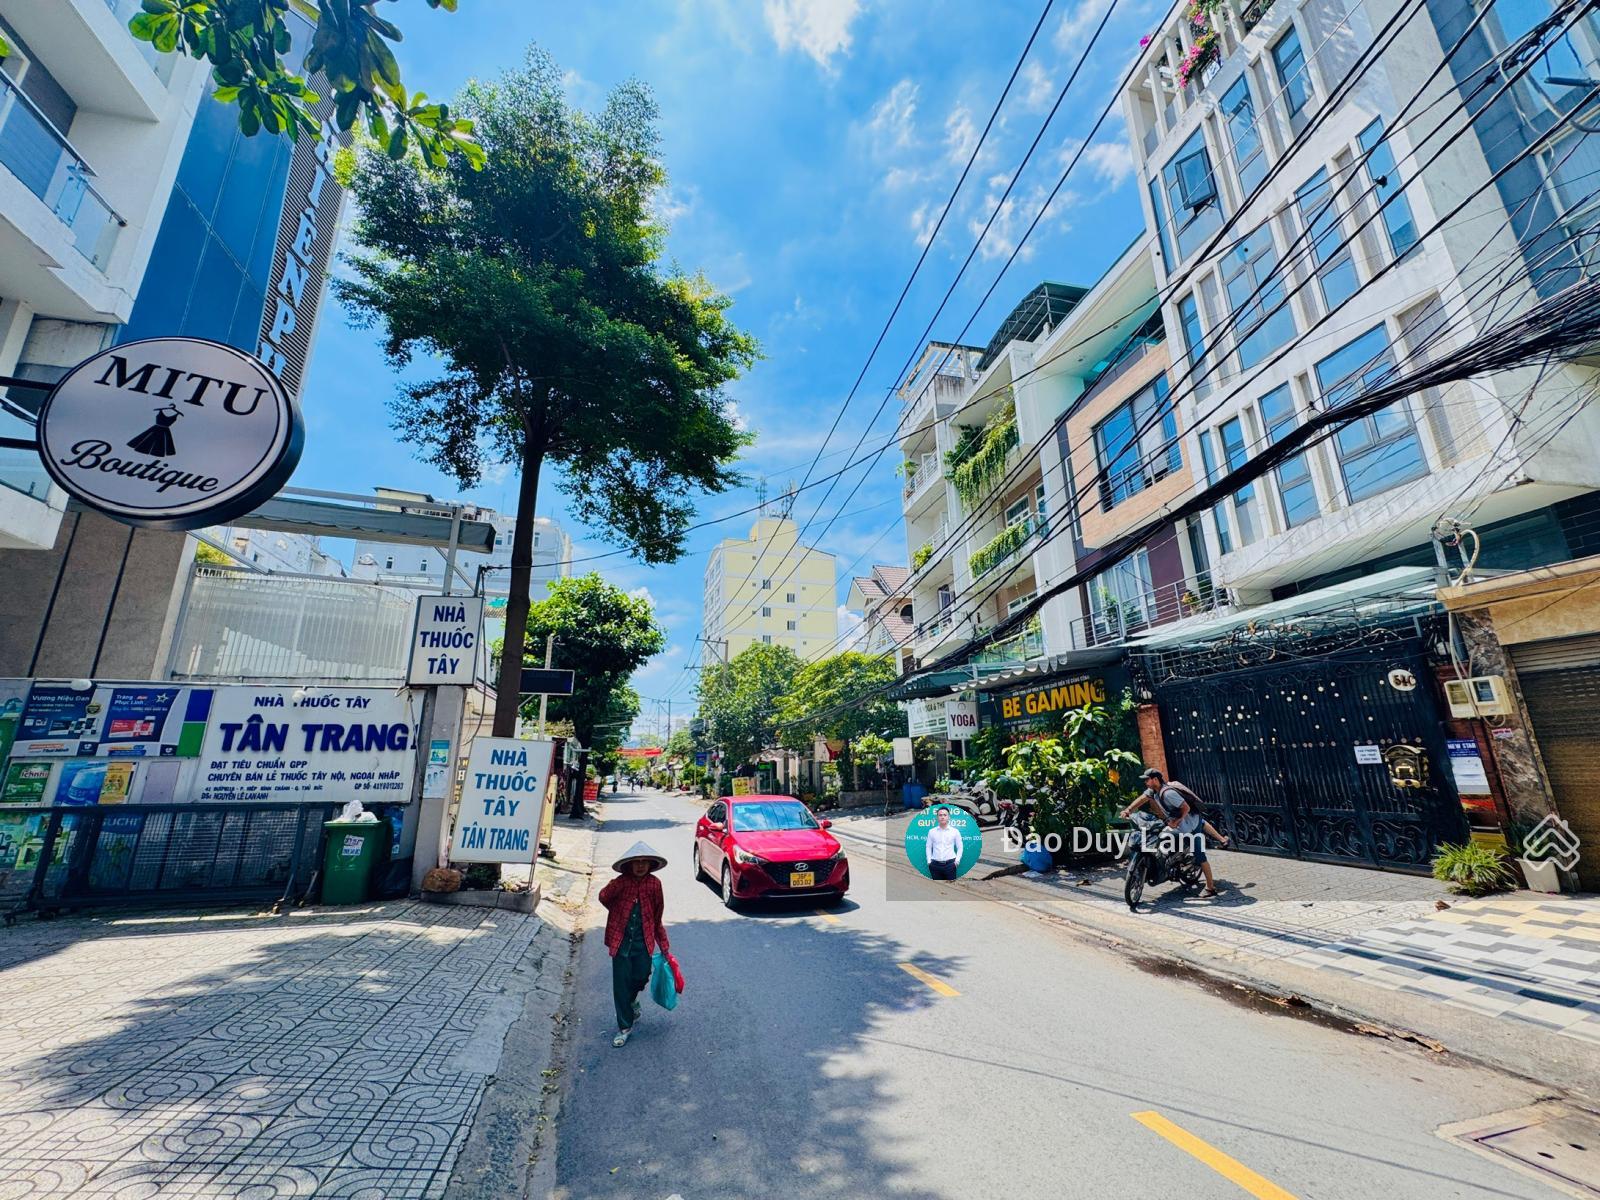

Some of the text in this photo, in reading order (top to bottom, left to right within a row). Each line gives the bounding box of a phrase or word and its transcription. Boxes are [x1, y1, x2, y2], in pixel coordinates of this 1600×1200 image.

[94, 355, 268, 416] MITU
[60, 439, 220, 493] Boutique
[433, 602, 466, 622] NHÀ
[419, 626, 474, 649] THUỐC
[427, 654, 460, 675] TÂY
[254, 693, 284, 707] NHÀ
[345, 695, 371, 709] TÂY
[1002, 697, 1021, 719] BE
[1026, 680, 1105, 715] GAMING
[950, 714, 976, 727] YOGA
[219, 713, 290, 752] TÂN
[301, 723, 409, 752] TRANG
[210, 760, 228, 770] ĐẠT
[231, 759, 252, 769] TIÊU
[290, 760, 307, 769] GPP
[490, 746, 527, 767] NHÀ
[208, 771, 242, 781] CHUYÊN
[245, 771, 263, 781] BÁN
[281, 769, 308, 781] THUỐC
[312, 770, 328, 781] TÂY
[474, 770, 536, 792] THUỐC
[483, 798, 520, 817] TÂY
[461, 822, 530, 851] TÂN TRANG
